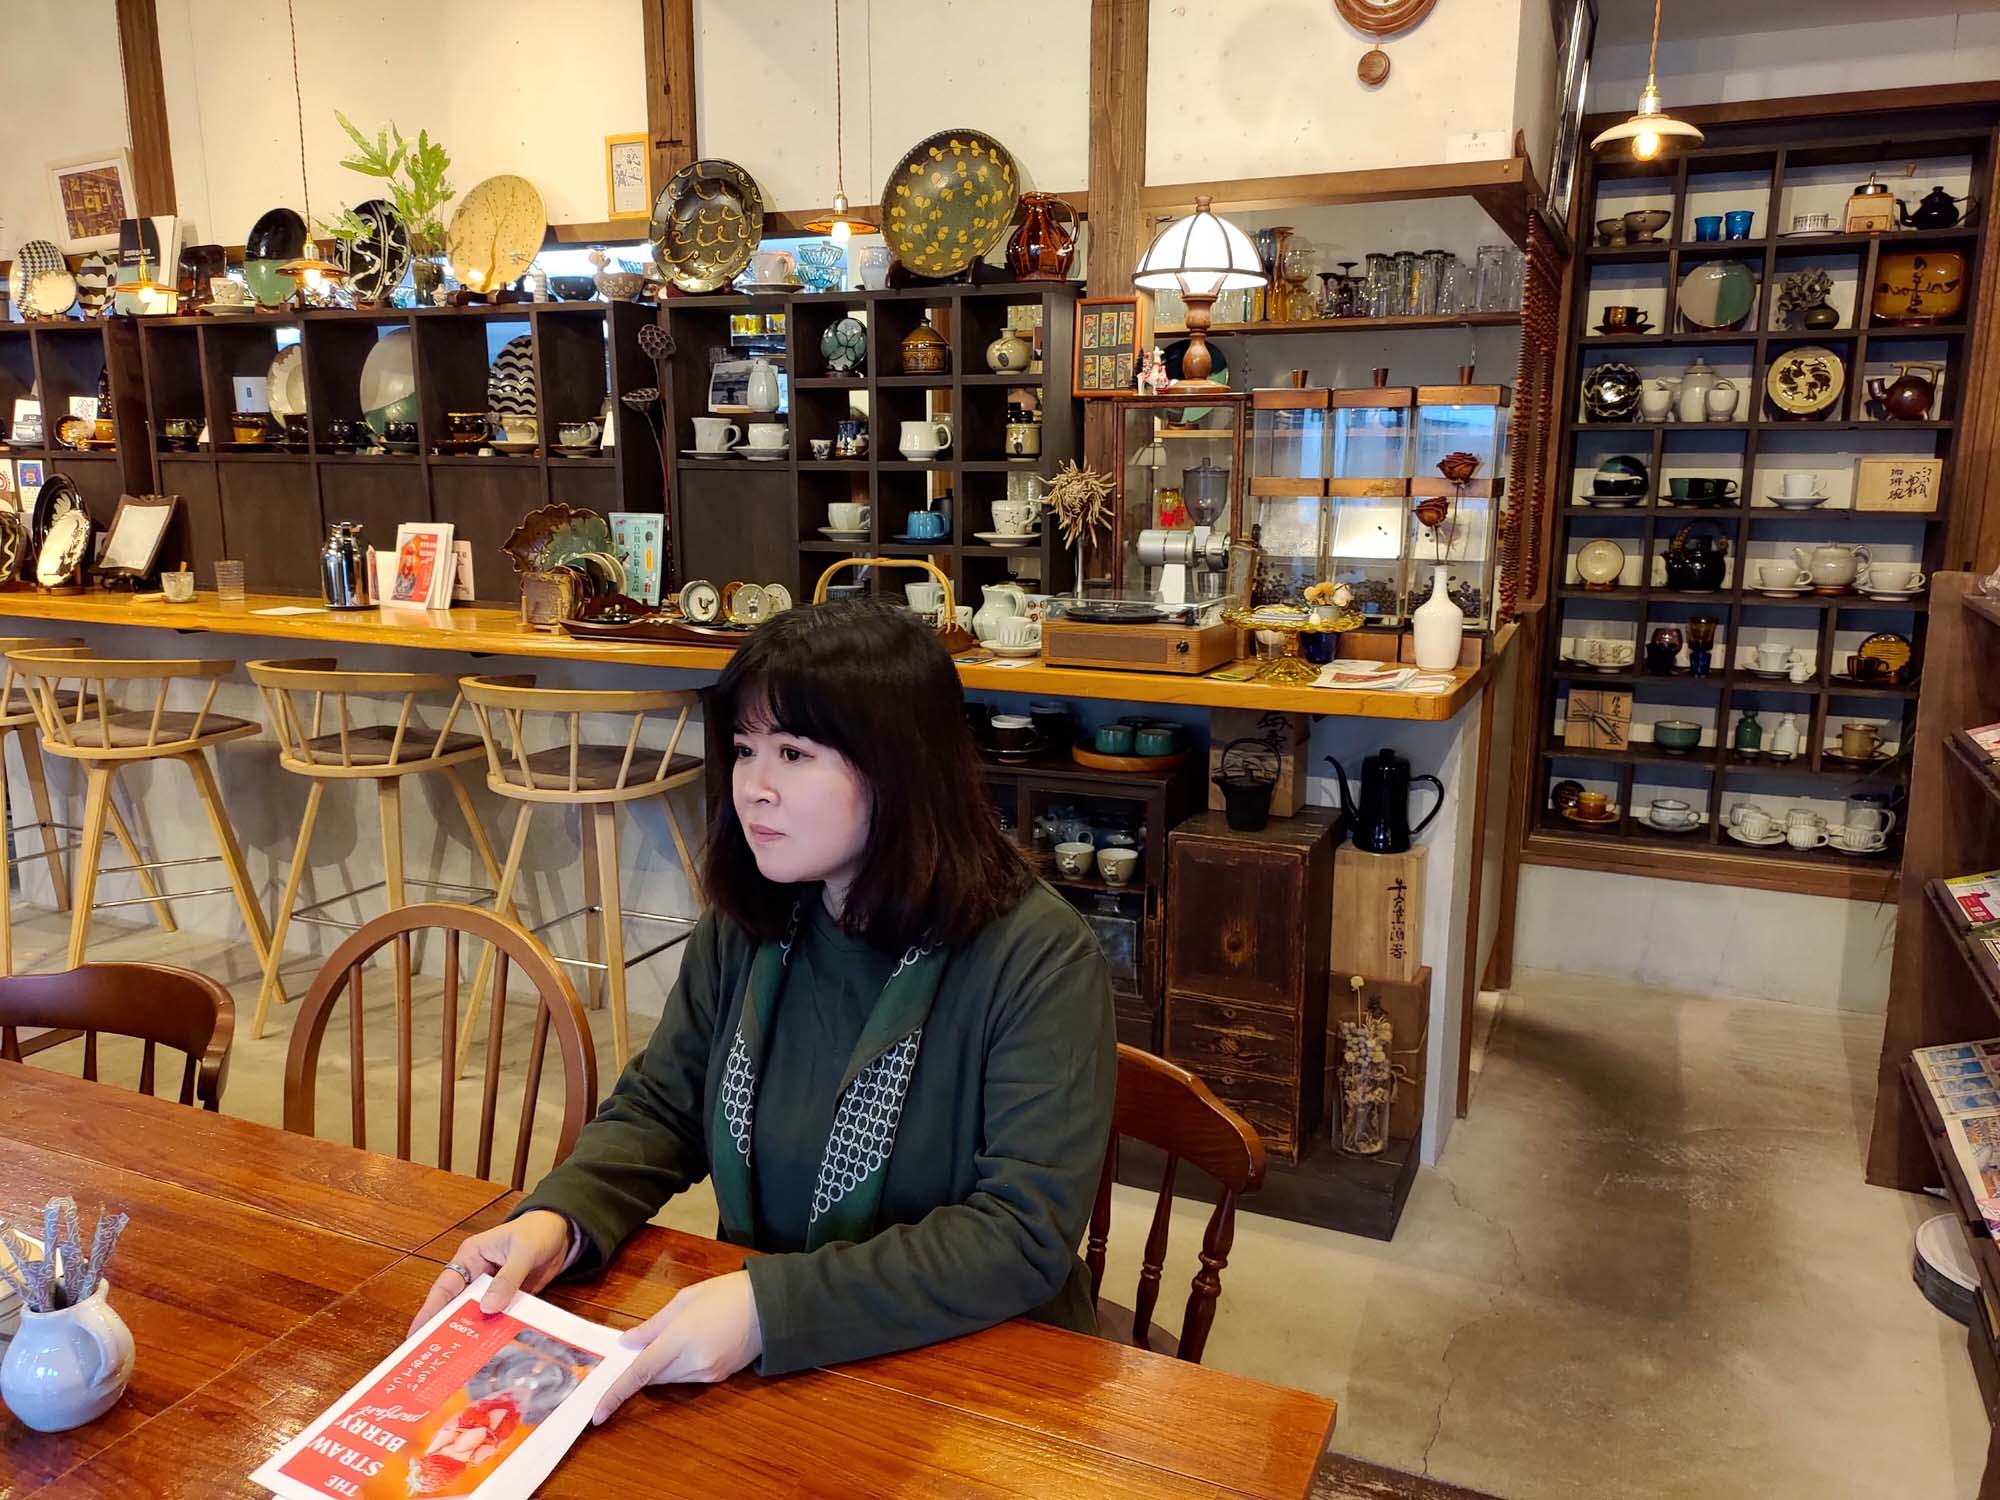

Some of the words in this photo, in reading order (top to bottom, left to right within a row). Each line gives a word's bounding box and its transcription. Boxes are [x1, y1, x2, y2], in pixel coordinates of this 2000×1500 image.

[384, 1342, 442, 1394] とっておきの
[406, 1341, 462, 1392] いちごパフェ
[335, 1413, 408, 1453] BERRY
[308, 1437, 384, 1477] STRAW
[324, 1475, 360, 1498] THE
